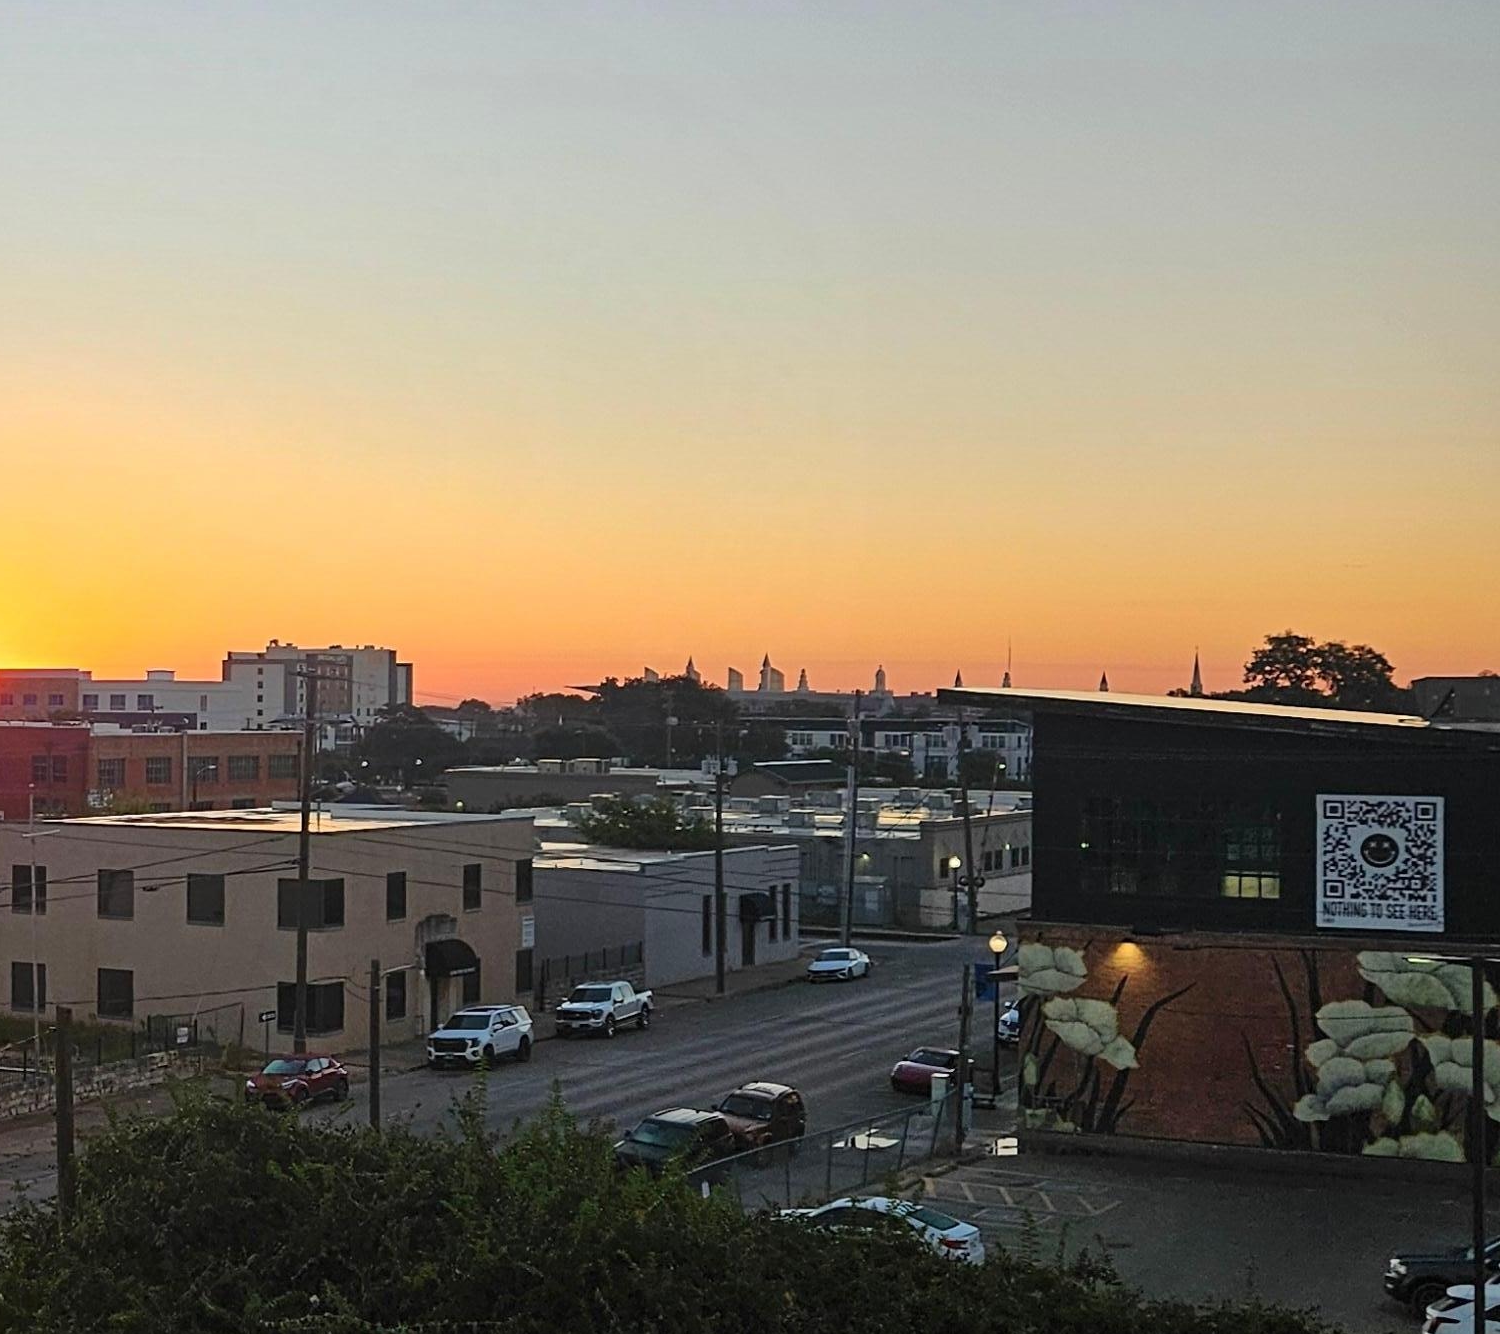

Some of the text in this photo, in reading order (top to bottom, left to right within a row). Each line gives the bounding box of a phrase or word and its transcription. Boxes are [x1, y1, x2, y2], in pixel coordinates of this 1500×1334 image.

[1322, 901, 1438, 921] NOTHING TO SEE HERE
